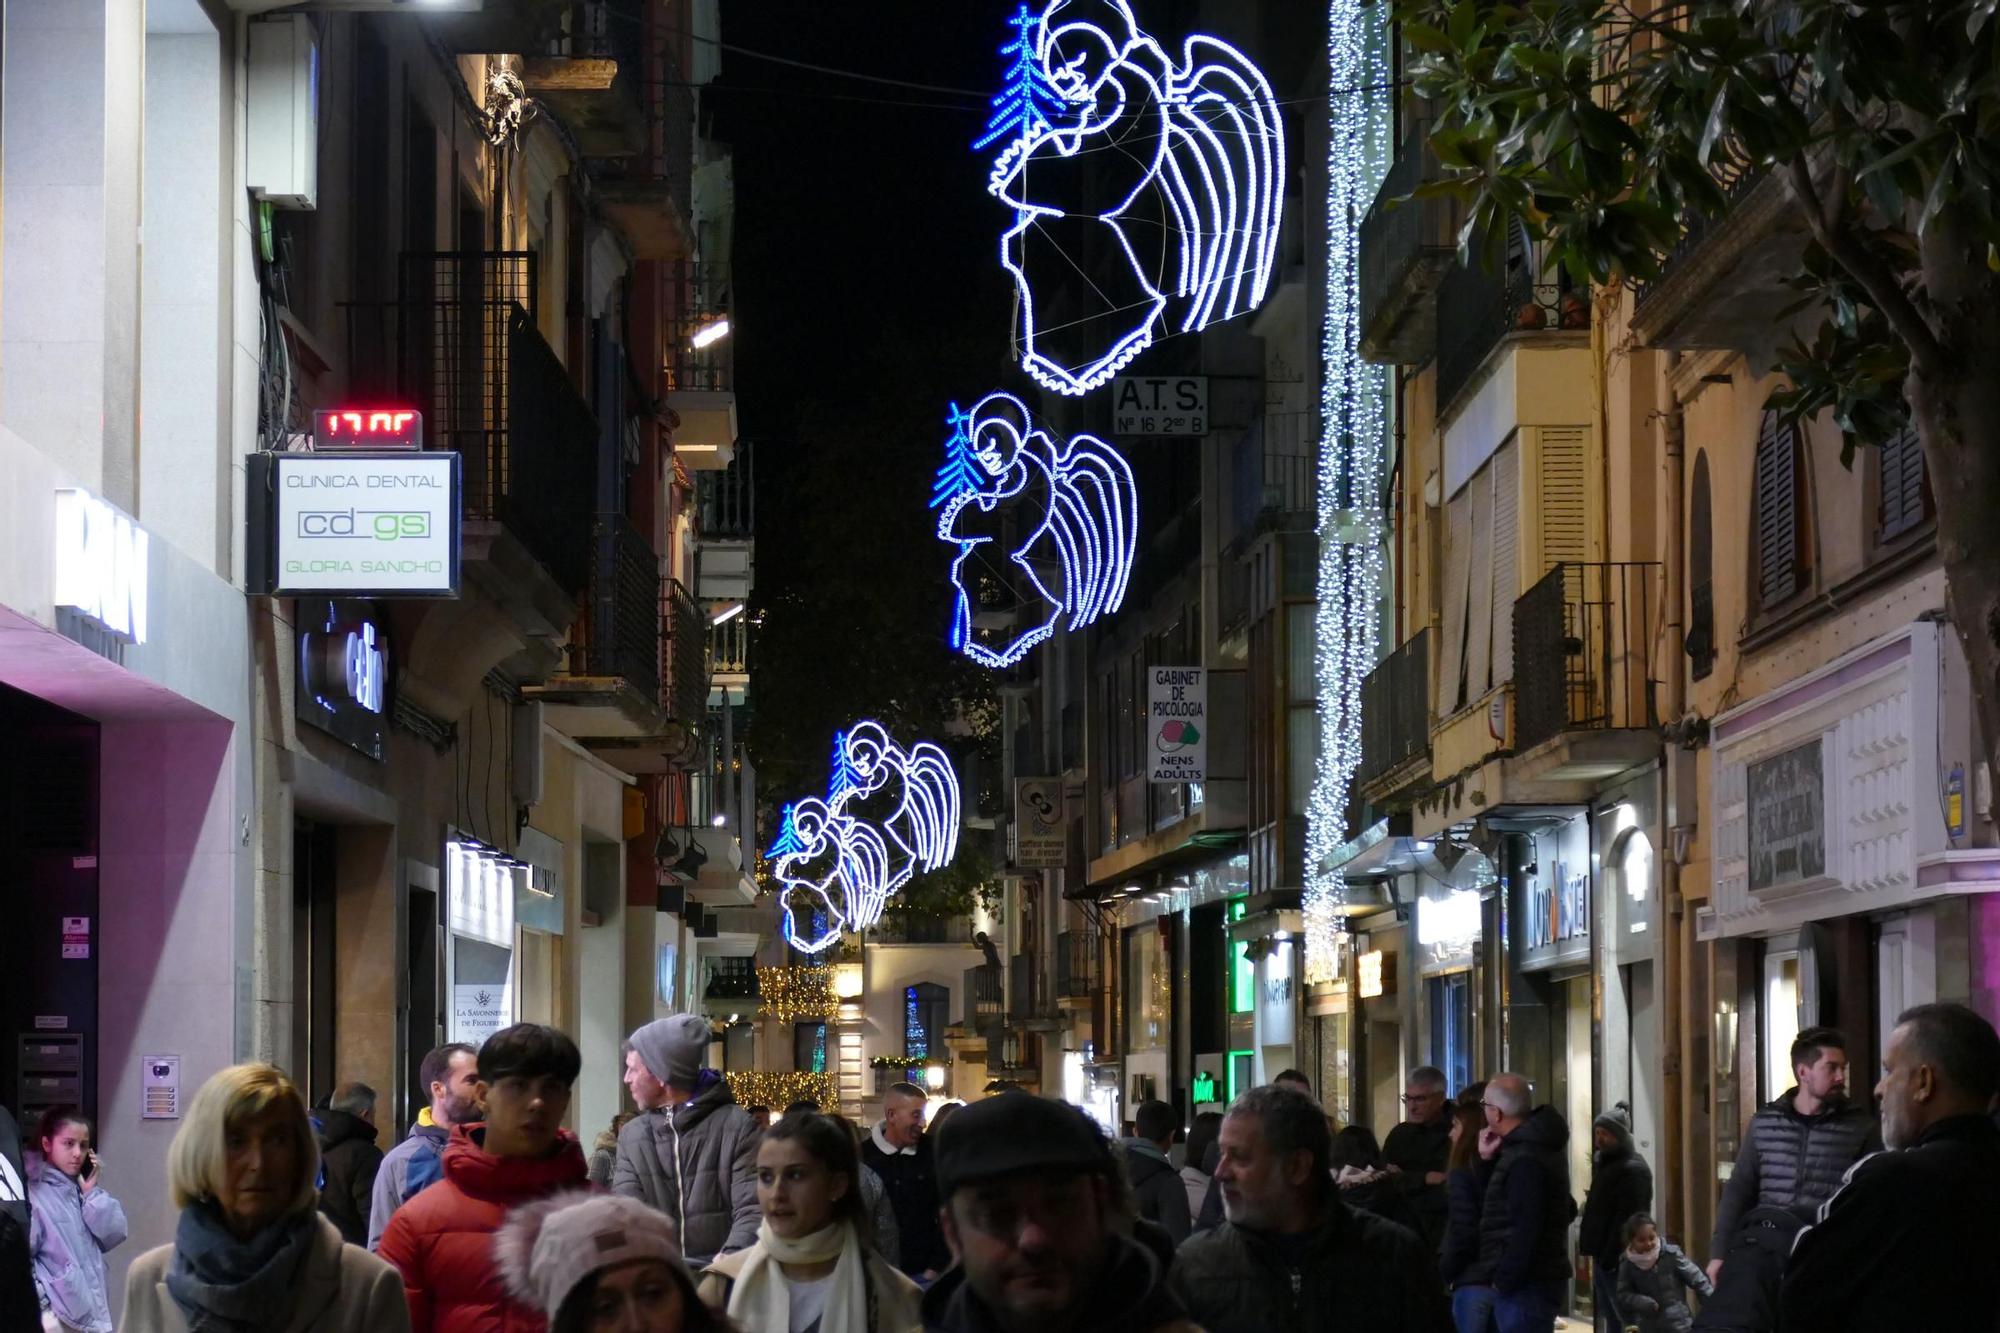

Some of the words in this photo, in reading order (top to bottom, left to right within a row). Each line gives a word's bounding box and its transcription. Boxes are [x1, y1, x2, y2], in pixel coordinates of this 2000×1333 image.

[1141, 417, 1155, 432] 16
[1192, 417, 1202, 432] B
[286, 475, 359, 488] CLINICA
[366, 475, 442, 488] DENTAL
[286, 560, 353, 573] GLORIA
[361, 560, 442, 573] SANCHO
[1156, 670, 1201, 685] GABINET
[1171, 686, 1185, 700] DE
[1153, 702, 1203, 717] PSICOLOGIA
[1161, 756, 1194, 765] NENS
[1154, 769, 1202, 779] ADULTS
